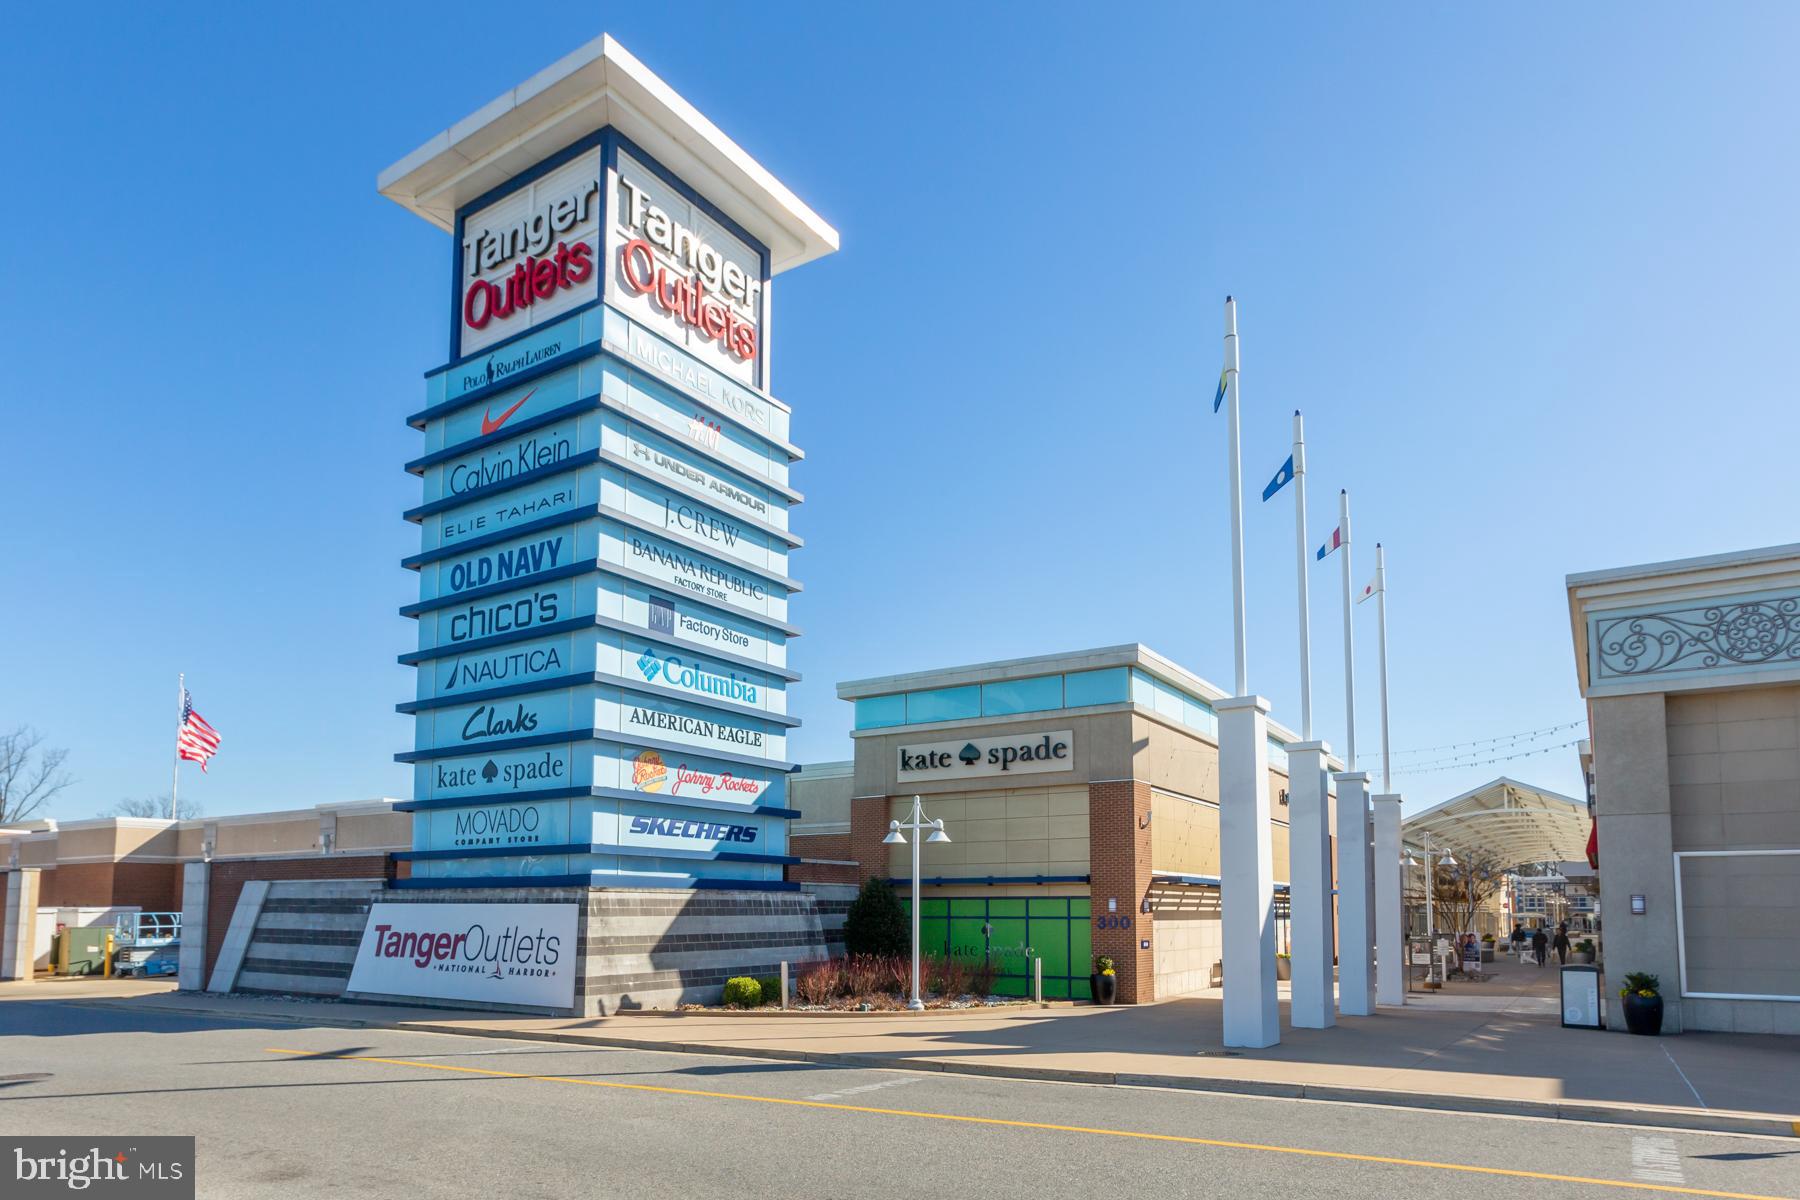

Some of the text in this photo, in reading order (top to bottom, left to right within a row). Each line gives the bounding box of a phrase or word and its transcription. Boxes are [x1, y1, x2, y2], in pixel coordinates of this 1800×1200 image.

[463, 180, 598, 276] Tanger
[619, 174, 760, 310] Tanger
[464, 241, 592, 330] Outlets
[622, 239, 757, 360] Outlets
[637, 336, 765, 426] MICHAEL KORS
[450, 432, 570, 495] Calvin Klein
[653, 453, 766, 514] UNDER ARMOUR
[445, 490, 573, 537] ELIE TAHARI
[450, 536, 563, 591] OLD NAVY
[633, 538, 764, 600] BANANA REPUBLIC
[674, 576, 728, 602] FACTORY STORE
[680, 614, 749, 648] Factory Store
[462, 647, 561, 685] NAUTICA
[662, 656, 757, 704] Columbia
[462, 703, 538, 741] Clarks
[629, 708, 762, 747] AMERICAN EAGLE
[437, 752, 563, 789] kate spade
[900, 736, 1067, 771] kate spade
[672, 763, 715, 796] Johnny
[714, 771, 759, 795] Rockets
[455, 806, 539, 836] MOVADO
[629, 816, 758, 843] SKECHERS
[455, 835, 540, 846] COMPANY STORE
[1097, 915, 1130, 929] 300
[438, 963, 550, 977] NATIONAL HARBOR
